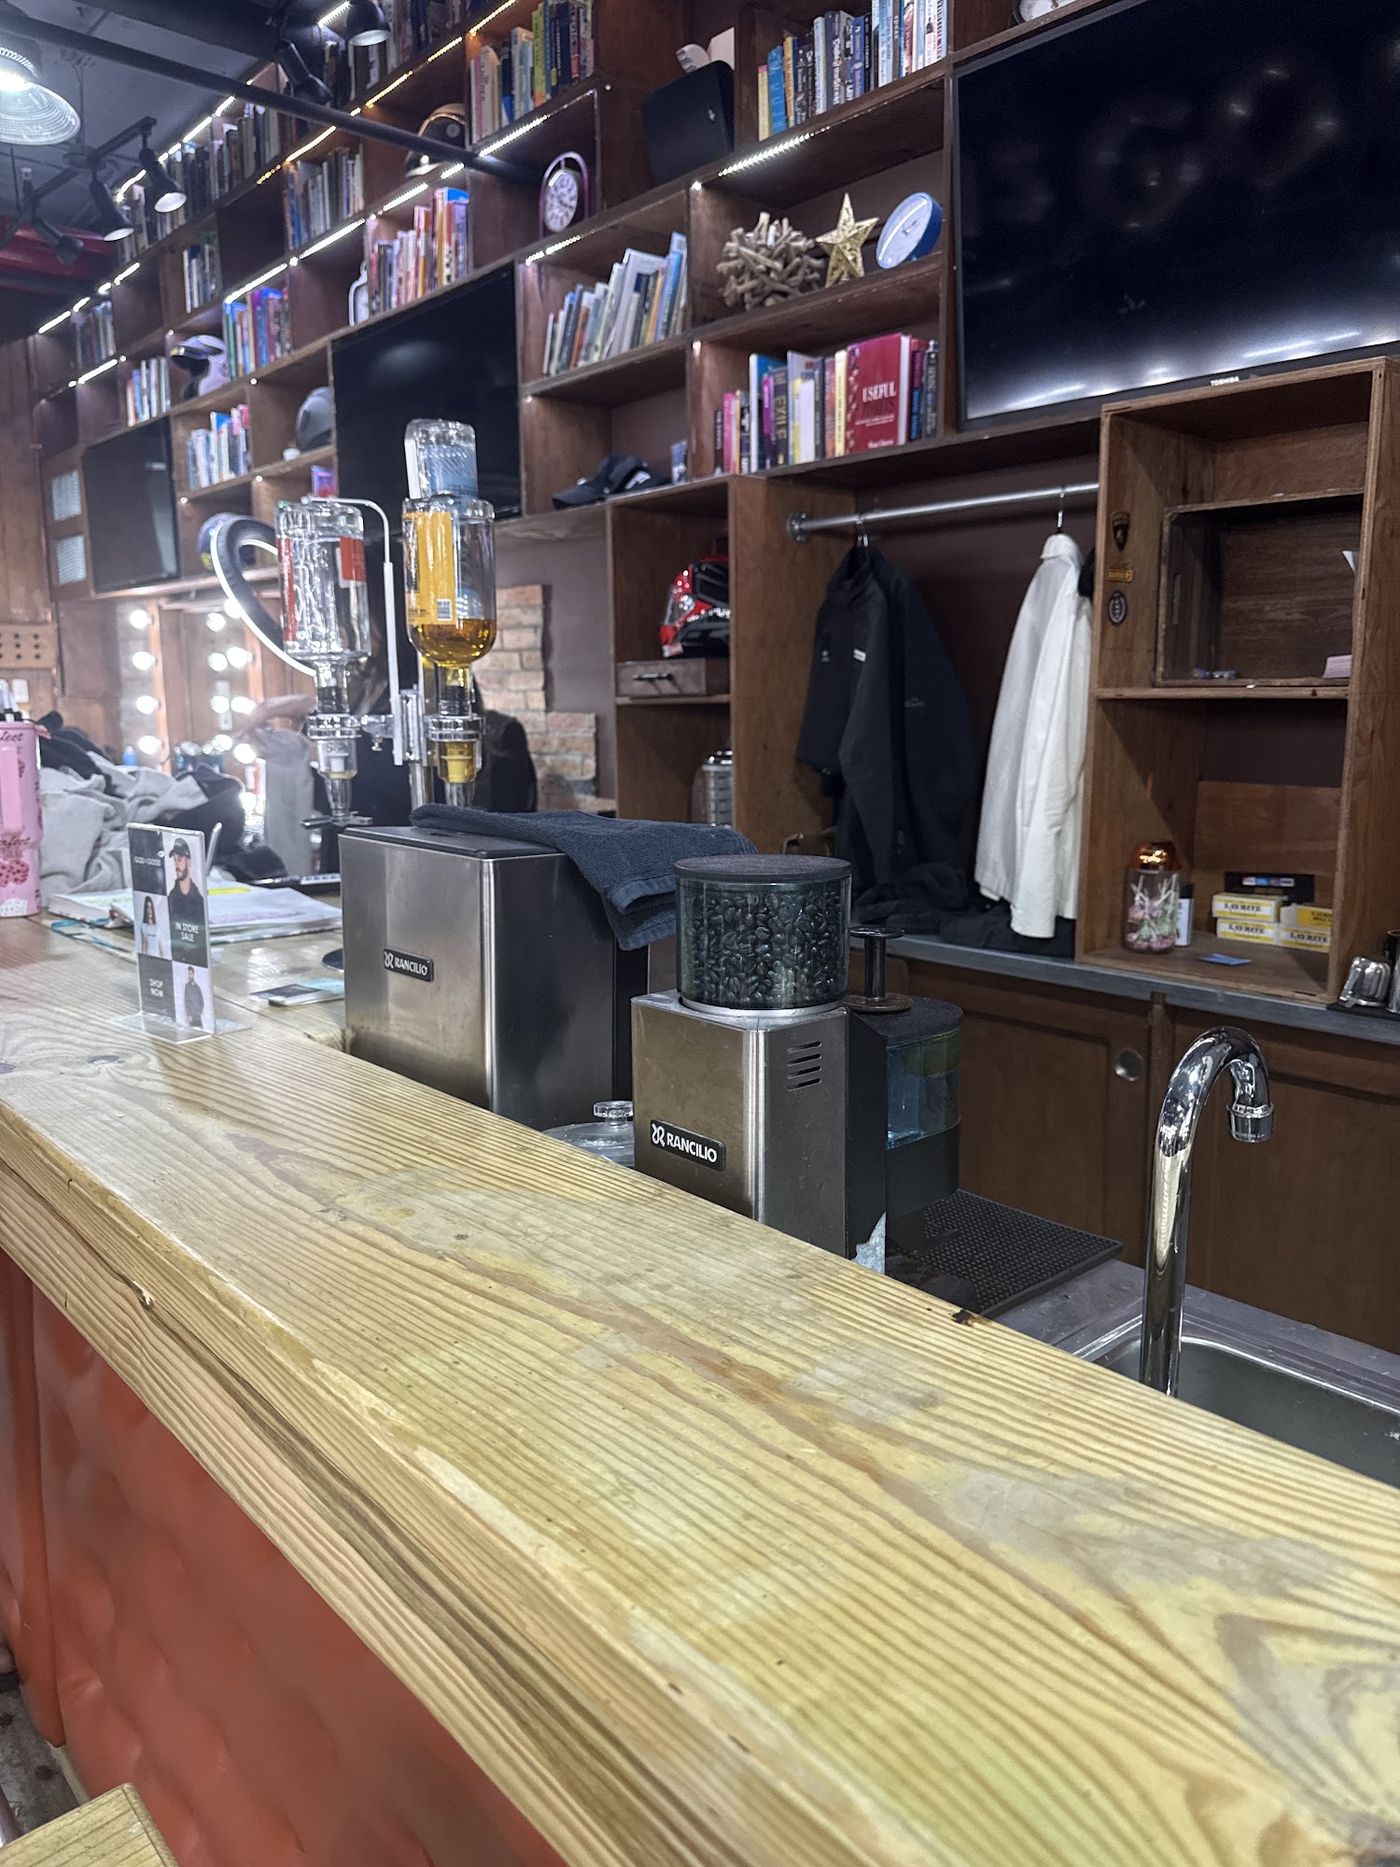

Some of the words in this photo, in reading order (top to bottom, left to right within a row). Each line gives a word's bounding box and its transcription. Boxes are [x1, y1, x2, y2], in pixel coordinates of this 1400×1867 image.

[1210, 375, 1239, 386] TOSHIBA
[862, 380, 897, 402] USEFUL
[774, 395, 787, 440] EXILE
[175, 922, 181, 930] IN
[182, 923, 199, 934] STORE
[181, 931, 194, 942] SALE
[394, 956, 428, 976] RANCILIO
[149, 978, 163, 987] SHOP
[150, 987, 163, 998] NOW
[665, 1134, 718, 1163] RANCILIO
